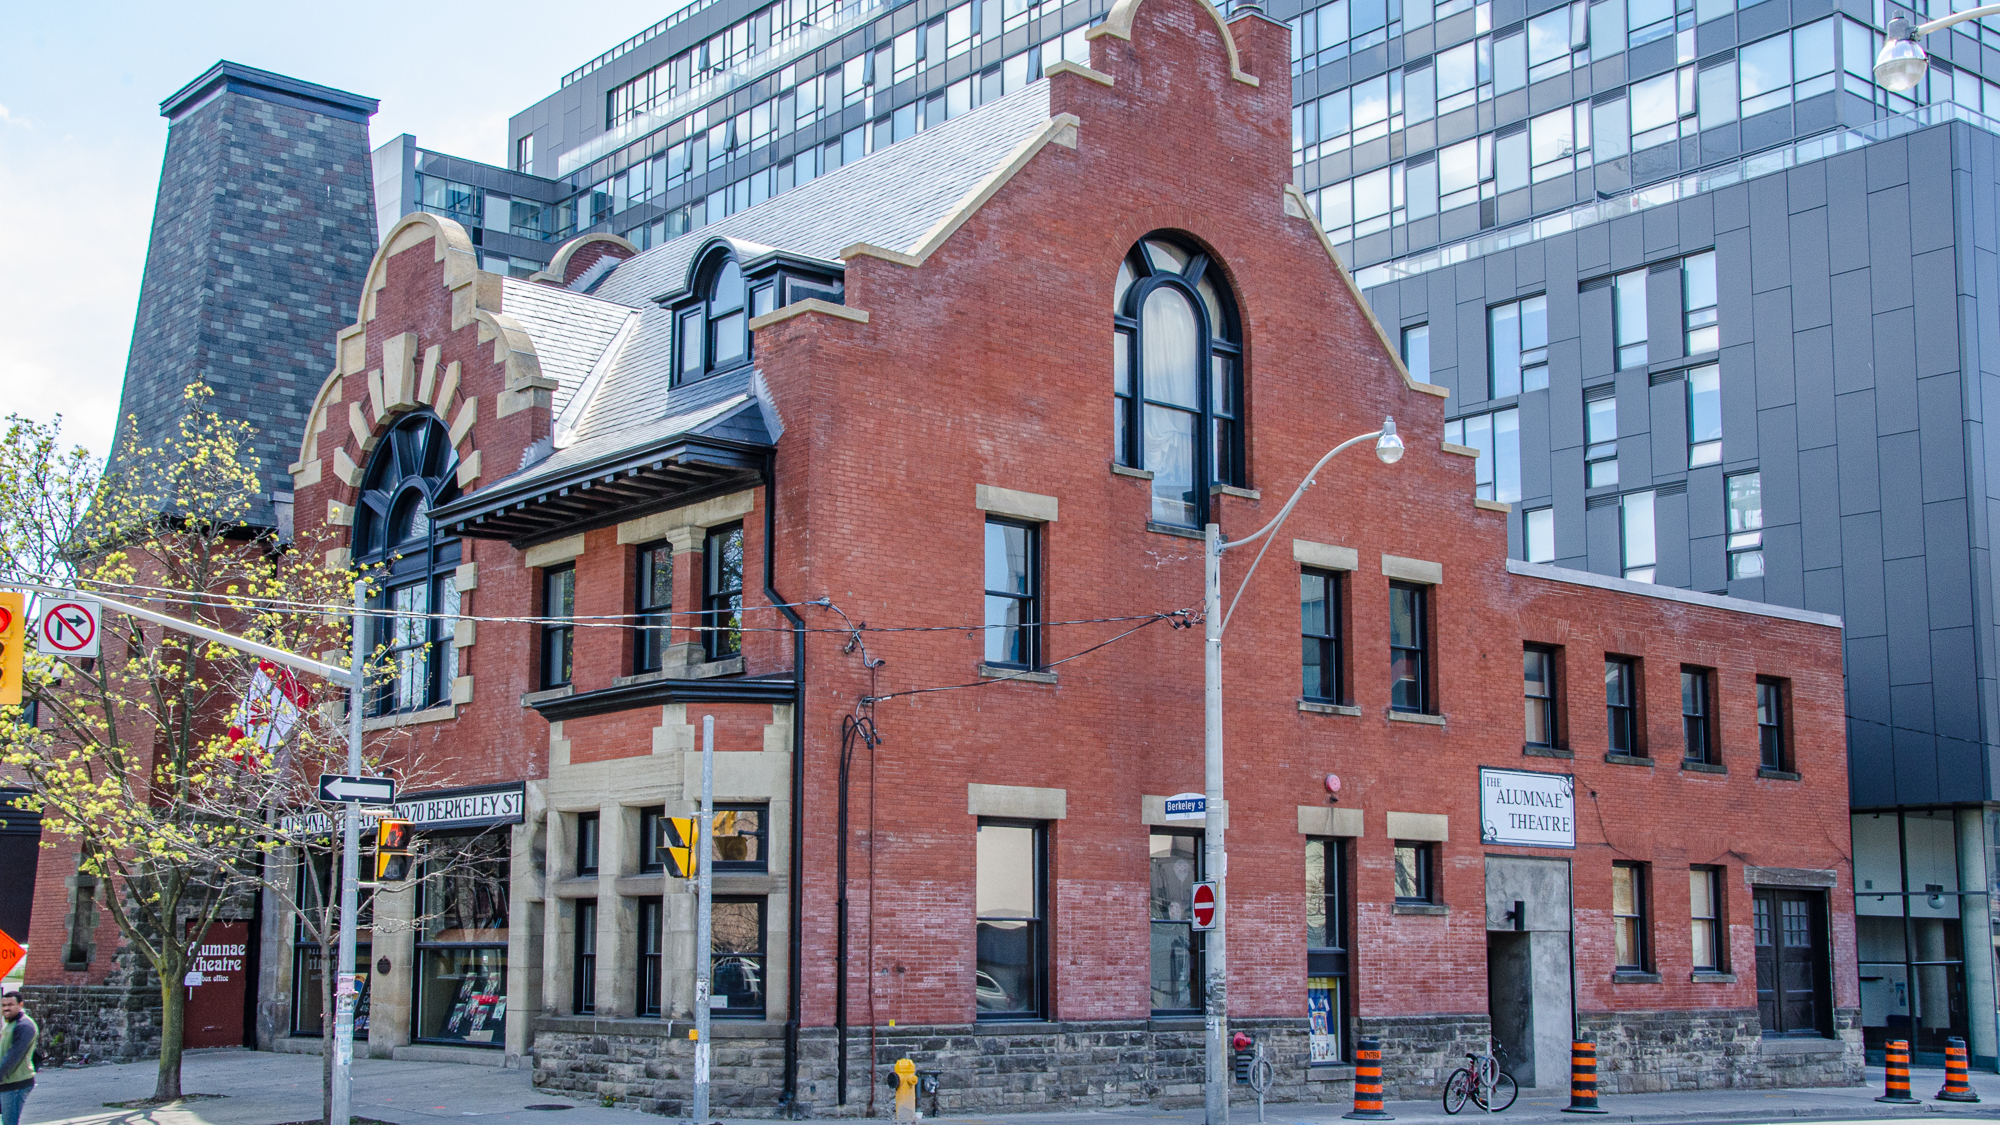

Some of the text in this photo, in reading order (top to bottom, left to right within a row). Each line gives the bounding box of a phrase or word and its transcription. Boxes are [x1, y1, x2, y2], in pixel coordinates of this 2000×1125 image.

[1486, 777, 1501, 787] THE
[1167, 801, 1204, 811] Berkeley St
[1496, 789, 1564, 808] ALUMNAE
[411, 803, 424, 822] 70
[427, 795, 500, 821] BERKELEY
[502, 794, 522, 814] ST
[1509, 813, 1571, 832] THEATRE
[187, 941, 246, 956] Aumnae
